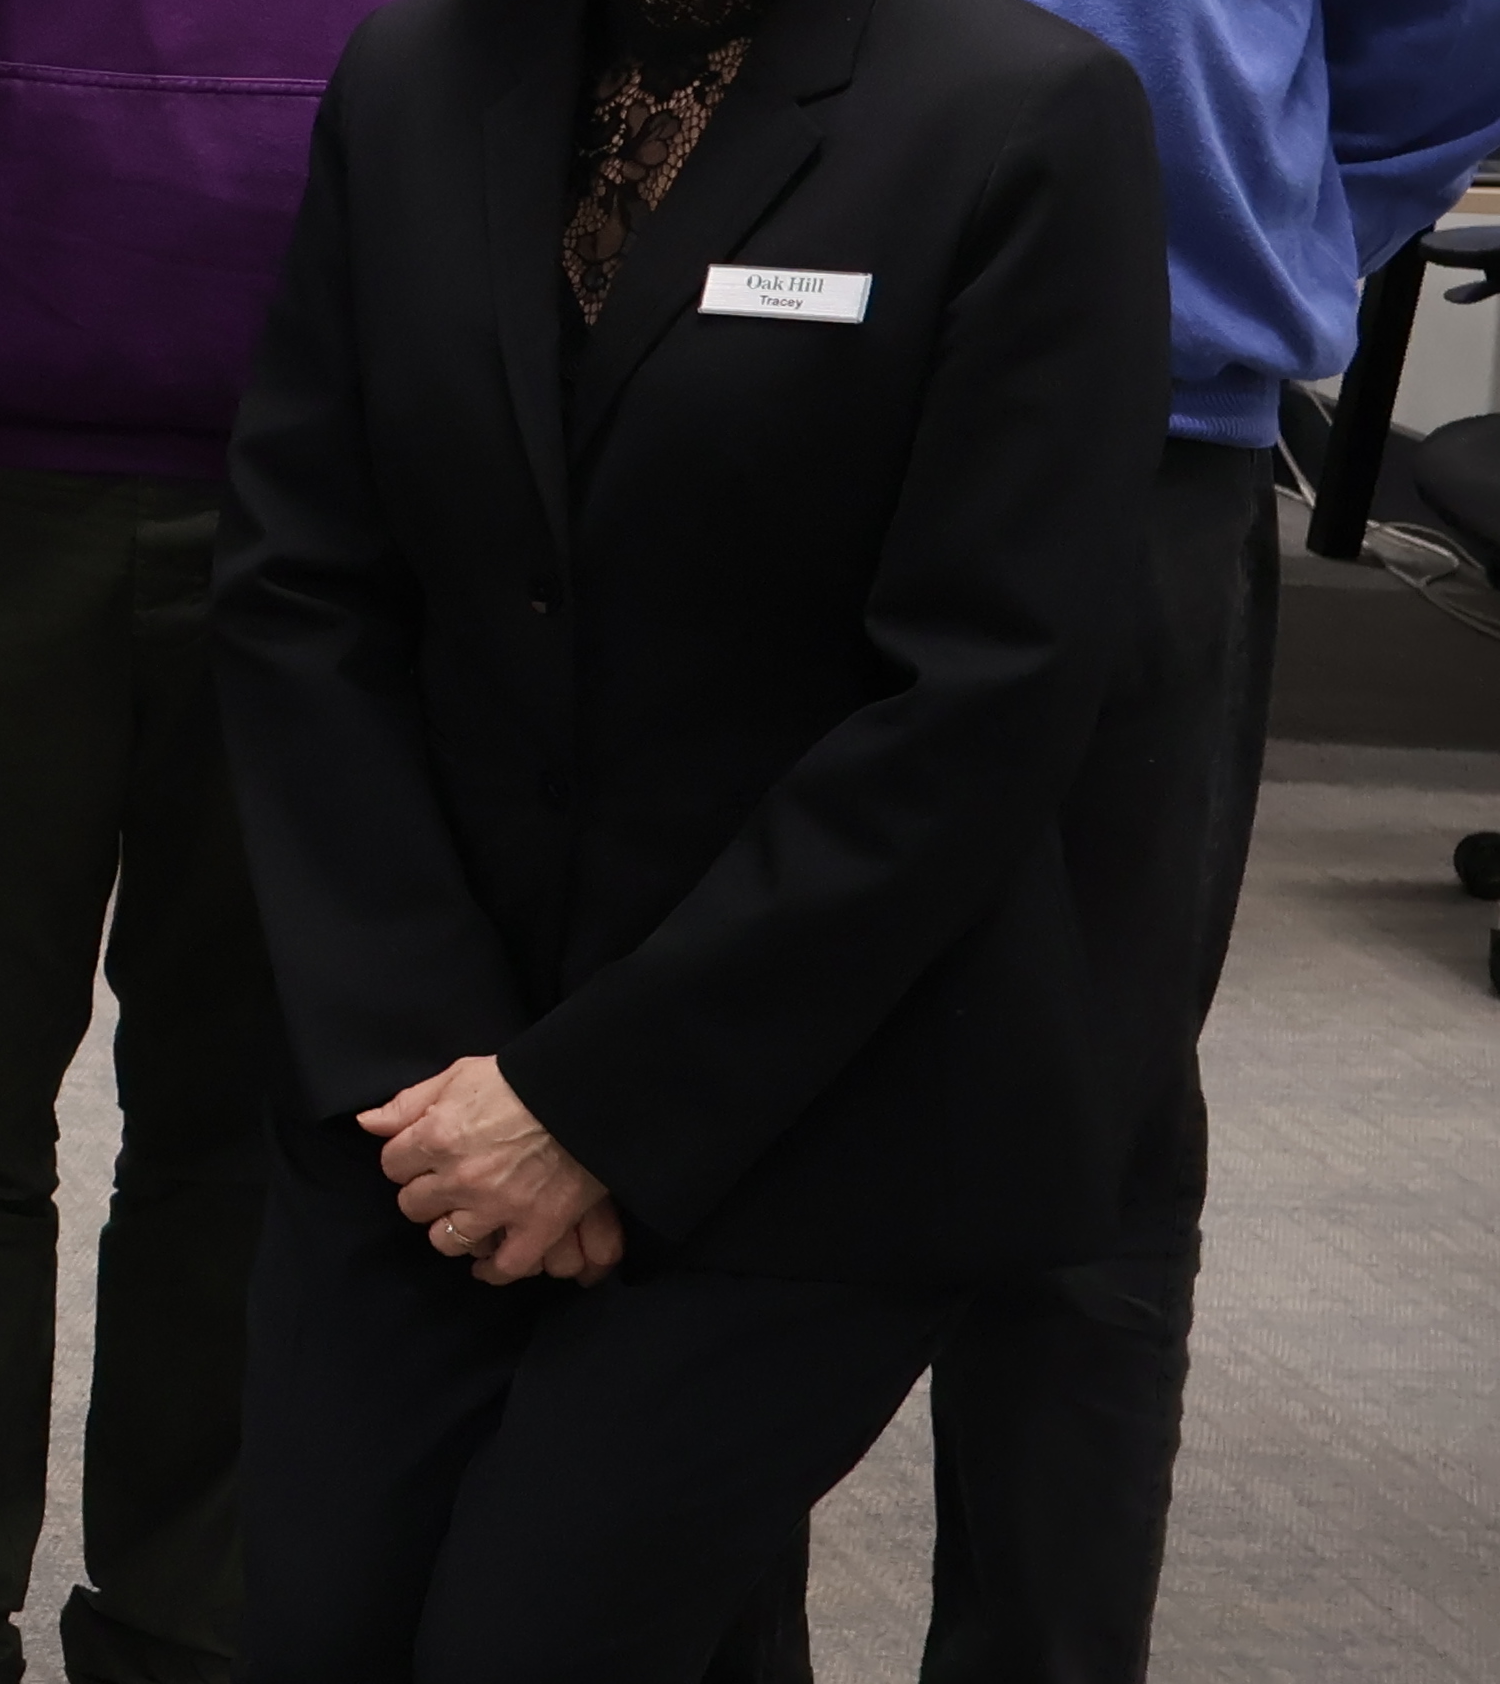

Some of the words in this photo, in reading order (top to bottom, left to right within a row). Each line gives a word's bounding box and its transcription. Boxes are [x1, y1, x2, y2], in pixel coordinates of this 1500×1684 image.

[746, 274, 784, 290] Oak
[789, 277, 824, 293] Hill
[760, 295, 803, 310] Tracey
